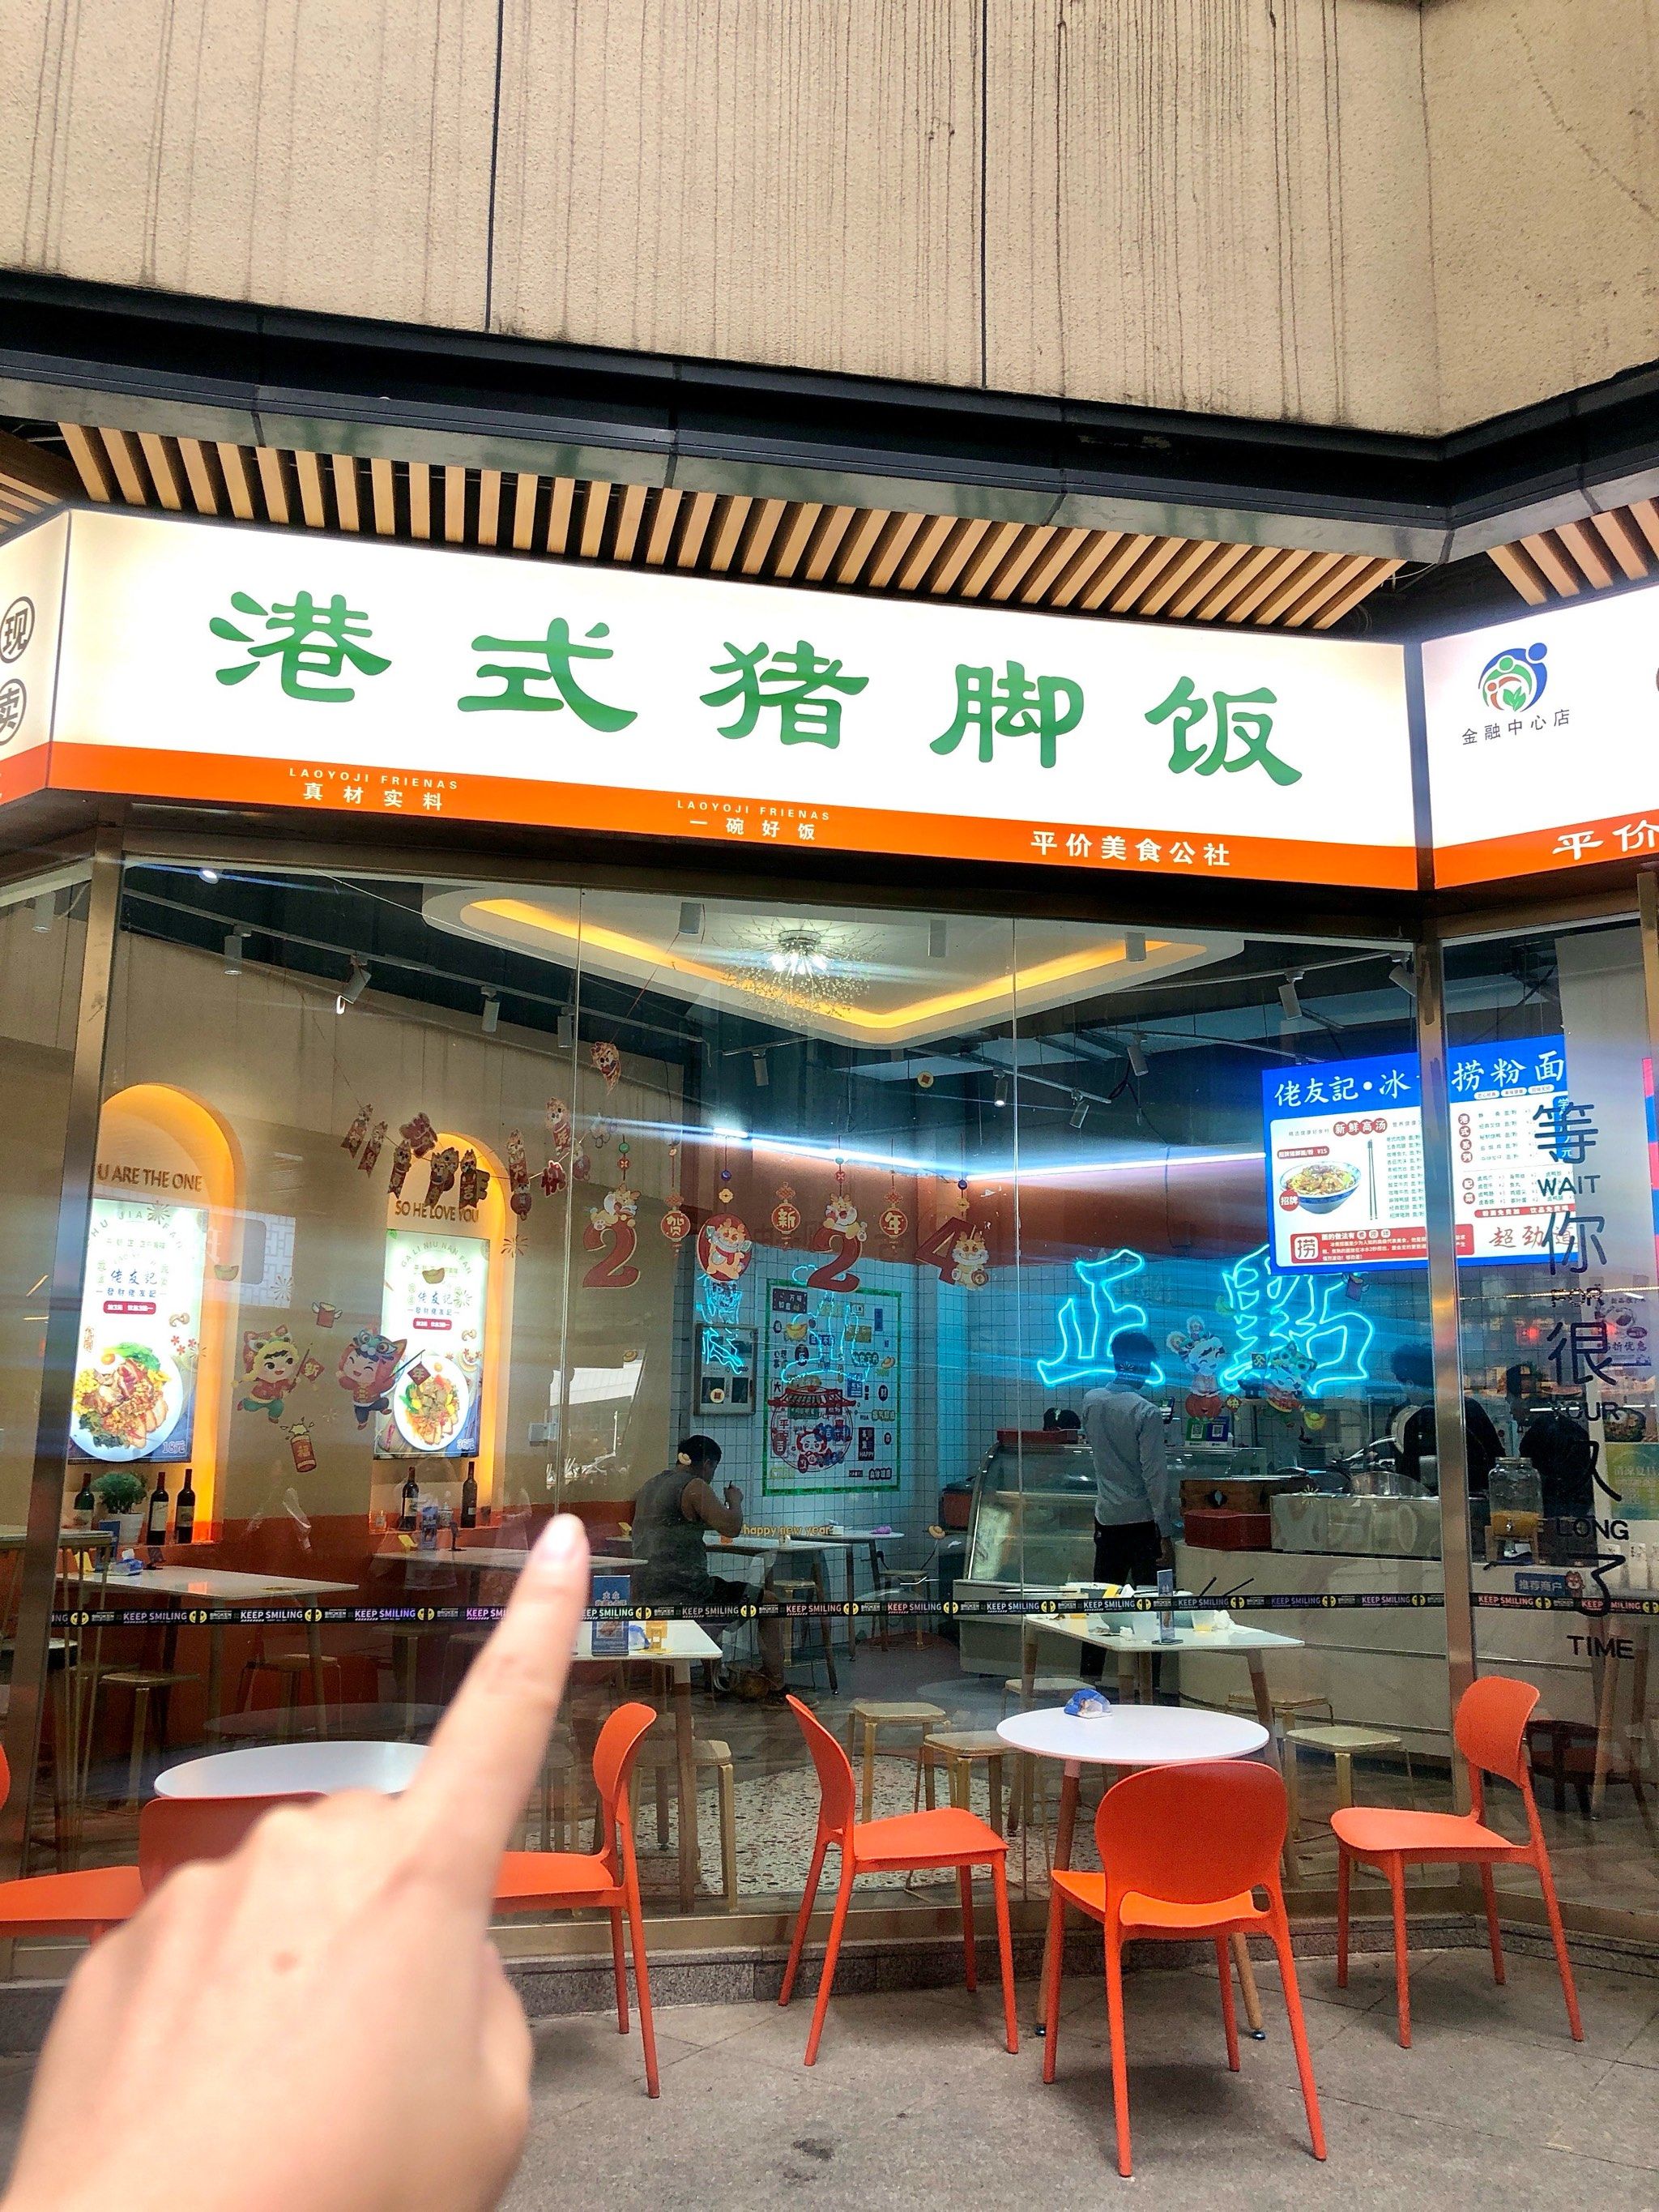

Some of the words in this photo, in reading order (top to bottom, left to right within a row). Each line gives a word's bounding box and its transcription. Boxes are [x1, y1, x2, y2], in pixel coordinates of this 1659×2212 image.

[209, 591, 1303, 787] 港式猪脚饭
[1461, 709, 1571, 745] 金融中心店
[289, 768, 369, 783] LAOYOJI
[380, 775, 458, 790] FRIENAS
[303, 782, 442, 811] 真材实料
[677, 800, 749, 814] LAOYOJI
[760, 807, 830, 821] FRIENAS
[689, 817, 815, 841] 一碗好饭
[1030, 830, 1231, 867] 平价美食公社
[1552, 819, 1659, 860] 平价
[1274, 1069, 1420, 1107] 佬友記·冰
[1451, 1050, 1565, 1092] 捞粉面
[1335, 1119, 1387, 1135] 新鲜高汤
[1533, 1101, 1599, 1164] 等
[112, 1165, 140, 1185] ARE
[143, 1168, 170, 1189] THE
[173, 1172, 203, 1192] ONE
[1537, 1175, 1601, 1197] WAIT
[1281, 1196, 1299, 1206] 招牌
[394, 1200, 412, 1216] SO
[413, 1202, 428, 1219] HE
[430, 1204, 456, 1221] LOVE
[458, 1206, 480, 1223] YOU
[666, 1215, 684, 1236] 贺
[778, 1209, 796, 1228] 新
[884, 1213, 904, 1234] 年
[423, 1241, 438, 1249] NIU
[1297, 1238, 1316, 1258] 捞
[1542, 1211, 1607, 1275] 你
[111, 1268, 157, 1285] 佬友記
[1546, 1322, 1617, 1386] 很
[162, 1440, 186, 1454] 18元
[742, 1523, 777, 1537] happy
[778, 1527, 802, 1536] new
[805, 1525, 831, 1537] year
[1555, 1518, 1630, 1540] LONG
[1567, 1552, 1627, 1617] 了
[787, 1605, 807, 1614] KEEP
[808, 1604, 842, 1613] SMILING
[888, 1603, 908, 1612] KEEP
[909, 1603, 942, 1611] SMILING
[987, 1603, 1006, 1611] KEEP
[1008, 1602, 1040, 1610] SMILING
[1104, 1600, 1135, 1608] SMILING
[1199, 1598, 1229, 1606] SMILING
[1290, 1596, 1321, 1604] SMILING
[1478, 1595, 1499, 1604] KEEP
[1500, 1597, 1533, 1606] SMILING
[1581, 1600, 1604, 1609] KEEP
[1608, 1601, 1641, 1610] MILING
[123, 1612, 147, 1621] KEEP
[149, 1611, 187, 1620] SMILING
[241, 1611, 264, 1620] KEEP
[265, 1610, 303, 1619] SMILING
[355, 1609, 377, 1618] KEEP
[379, 1609, 416, 1618] SMILING
[467, 1608, 489, 1617] KEEP
[580, 1608, 598, 1617] EEP
[599, 1608, 633, 1617] SMILING
[682, 1606, 704, 1615] KEEP
[705, 1605, 739, 1614] SMILING
[1567, 1635, 1635, 1659] TIME
